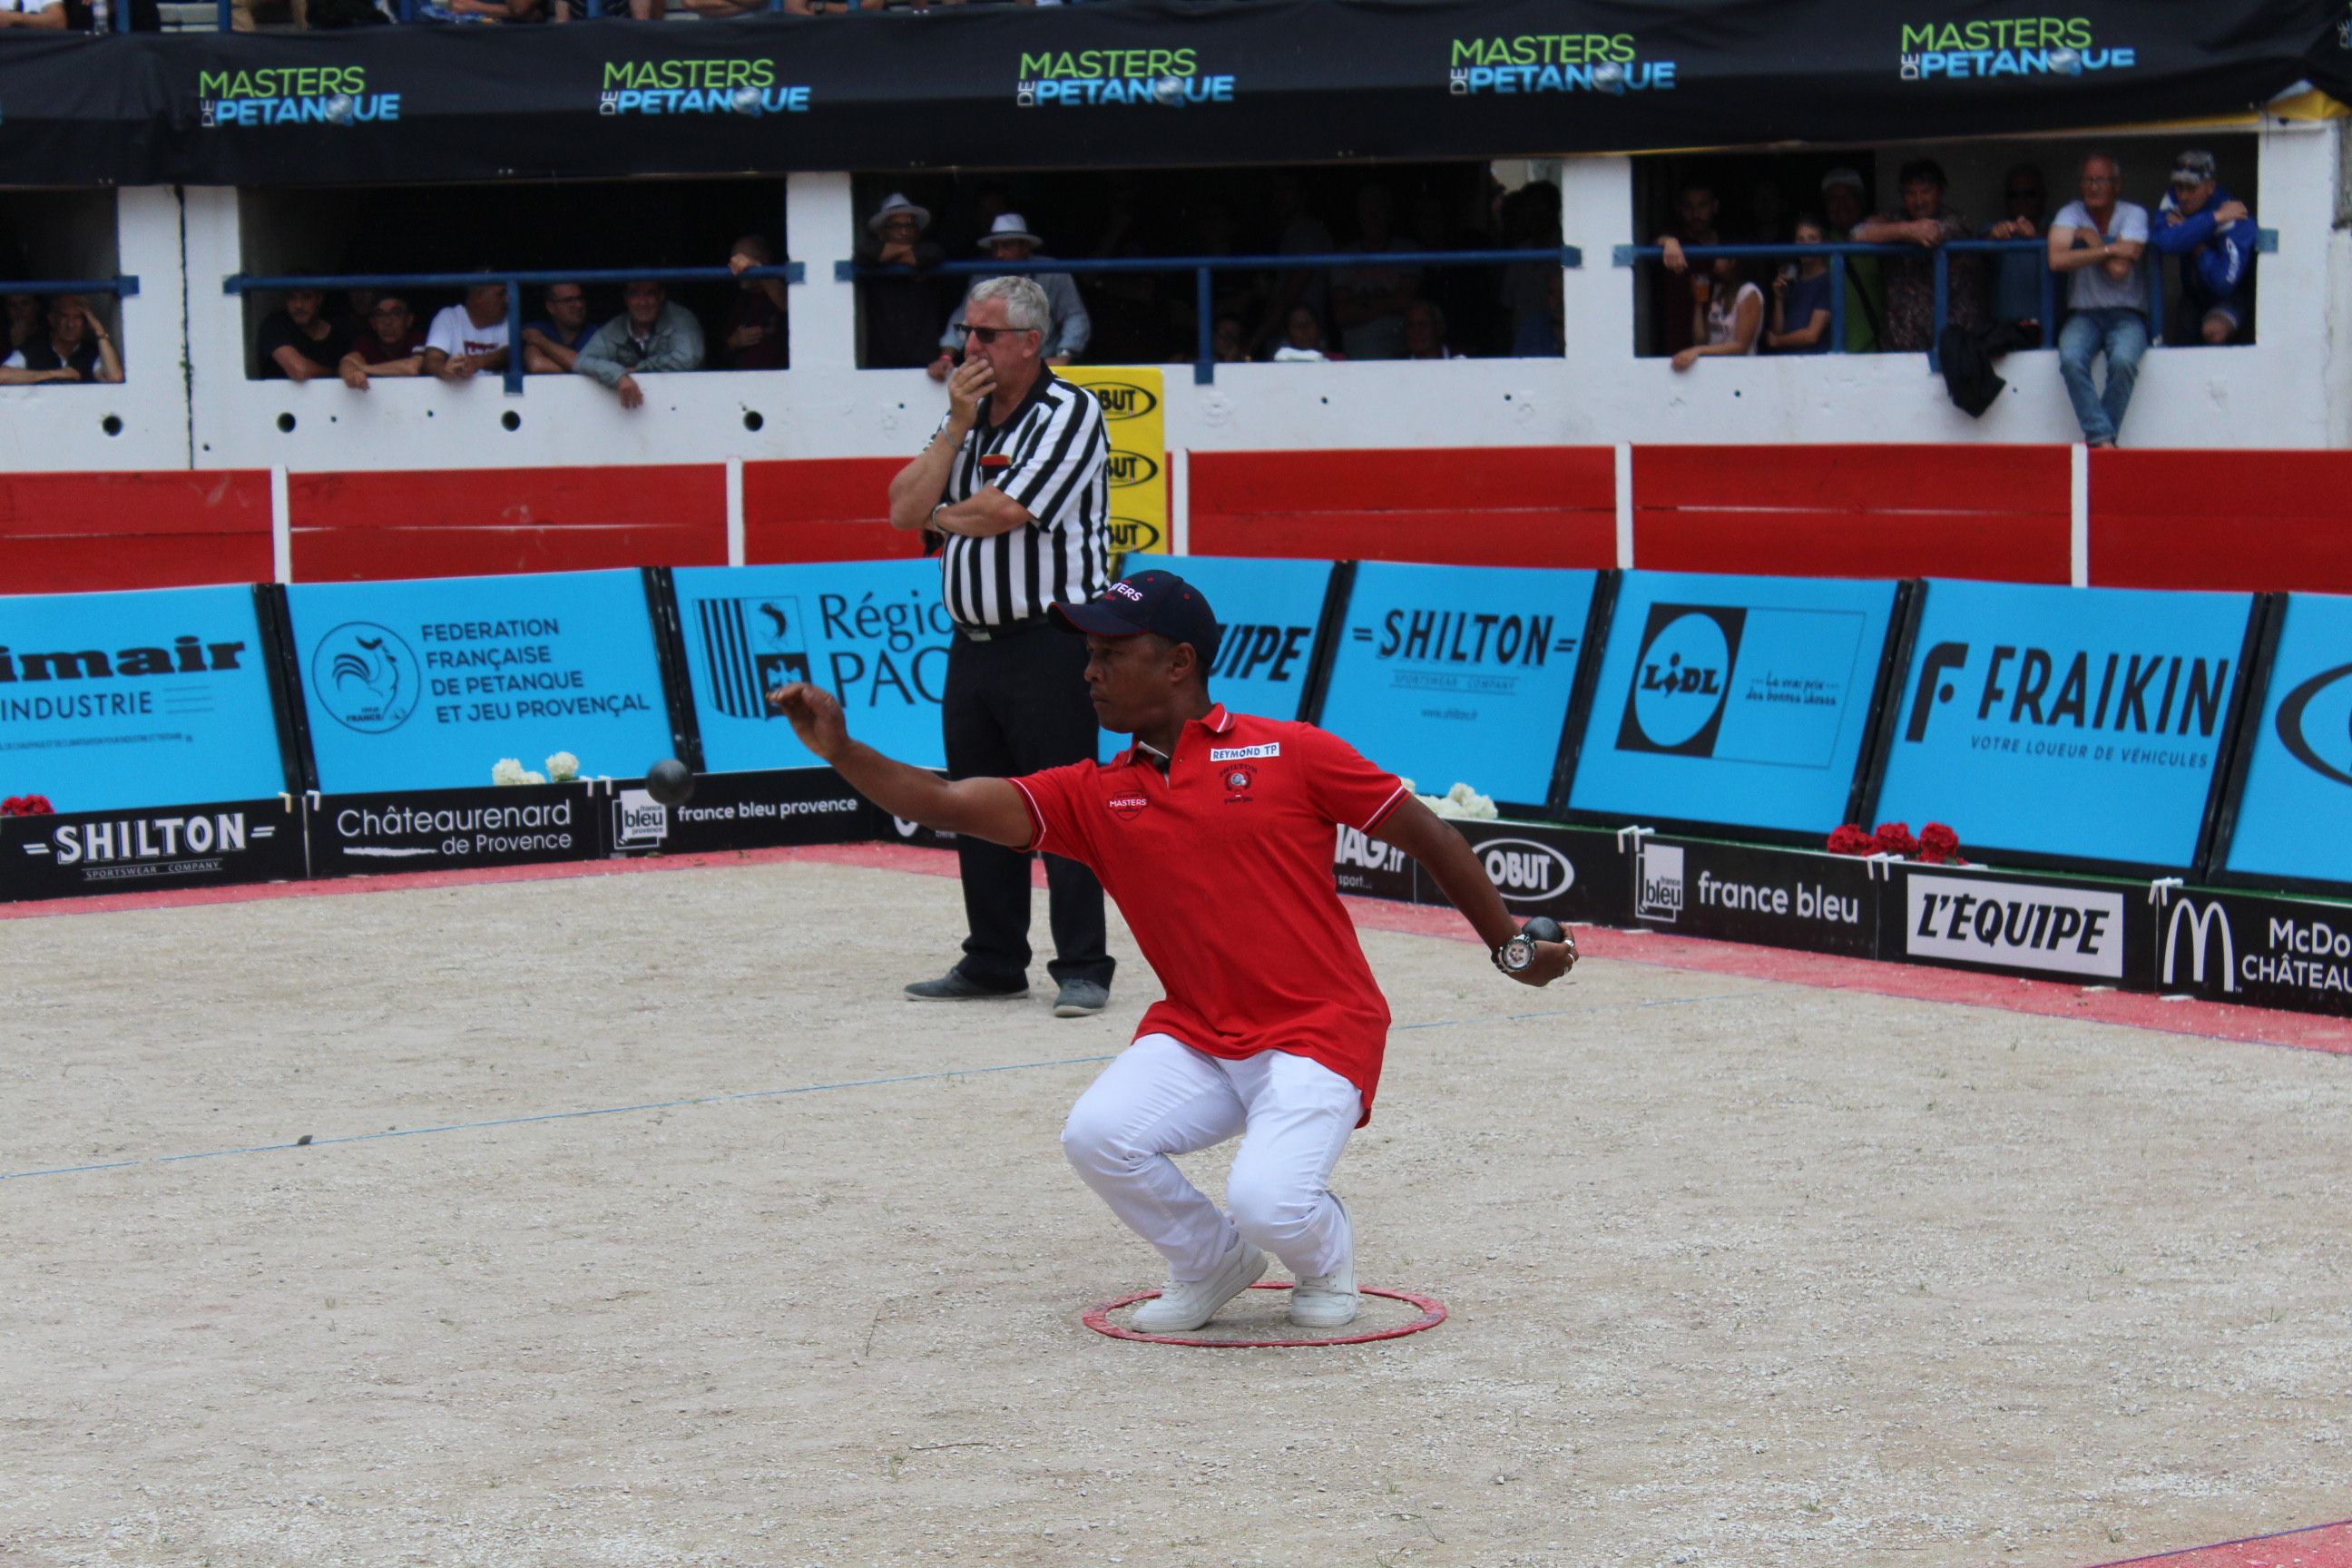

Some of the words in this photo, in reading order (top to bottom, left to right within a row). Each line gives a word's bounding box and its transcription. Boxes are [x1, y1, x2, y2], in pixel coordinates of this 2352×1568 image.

[1452, 34, 1635, 66] MASTERS
[1902, 17, 2092, 53] MASTERS
[603, 59, 775, 89] MASTERS
[1020, 48, 1198, 79] MASTERS
[1919, 46, 2135, 77] PETANQUE
[200, 66, 366, 98] MASTERS
[1035, 75, 1235, 107] PETANQUE
[1468, 61, 1676, 94] PETANQUE
[215, 93, 400, 126] PETANQUE
[618, 86, 810, 116] PETANQUE
[1093, 389, 1136, 411] BUT
[1108, 582, 1143, 601] TERS
[421, 618, 559, 642] FEDERATION
[1377, 608, 1554, 667] SHILTON
[426, 645, 552, 671] FRANÇAISE
[431, 678, 460, 696] DE
[466, 671, 583, 694] PETANQUE
[1976, 645, 2230, 737] FRAIKIN
[1, 691, 152, 722] INDUSTRIE
[436, 705, 461, 723] ET
[467, 702, 511, 722] JEU
[518, 693, 651, 720] PROVENÇAL
[1212, 747, 1260, 760] REYMOND
[1264, 744, 1277, 755] TP
[1971, 735, 2019, 752] VOTRE
[2025, 740, 2087, 759] LOUEUR
[2093, 747, 2114, 761] DE
[337, 799, 572, 838] Châteaurenard
[624, 809, 663, 828] bleu
[677, 806, 734, 822] france
[739, 802, 776, 818] bleu
[779, 797, 858, 819] provence
[1109, 799, 1147, 808] MASTERS
[54, 812, 246, 864] SHILTON
[442, 837, 470, 856] de
[475, 833, 573, 853] Provence
[1334, 823, 1406, 873] AG.fr
[86, 866, 157, 879] SPORTSWEAR
[168, 861, 219, 872] COMPANY
[1485, 848, 1552, 891] OBUT
[1645, 879, 1681, 906] bleu
[1698, 870, 1789, 915] france
[1797, 882, 1858, 924] bleu
[2269, 916, 2351, 958] McDo
